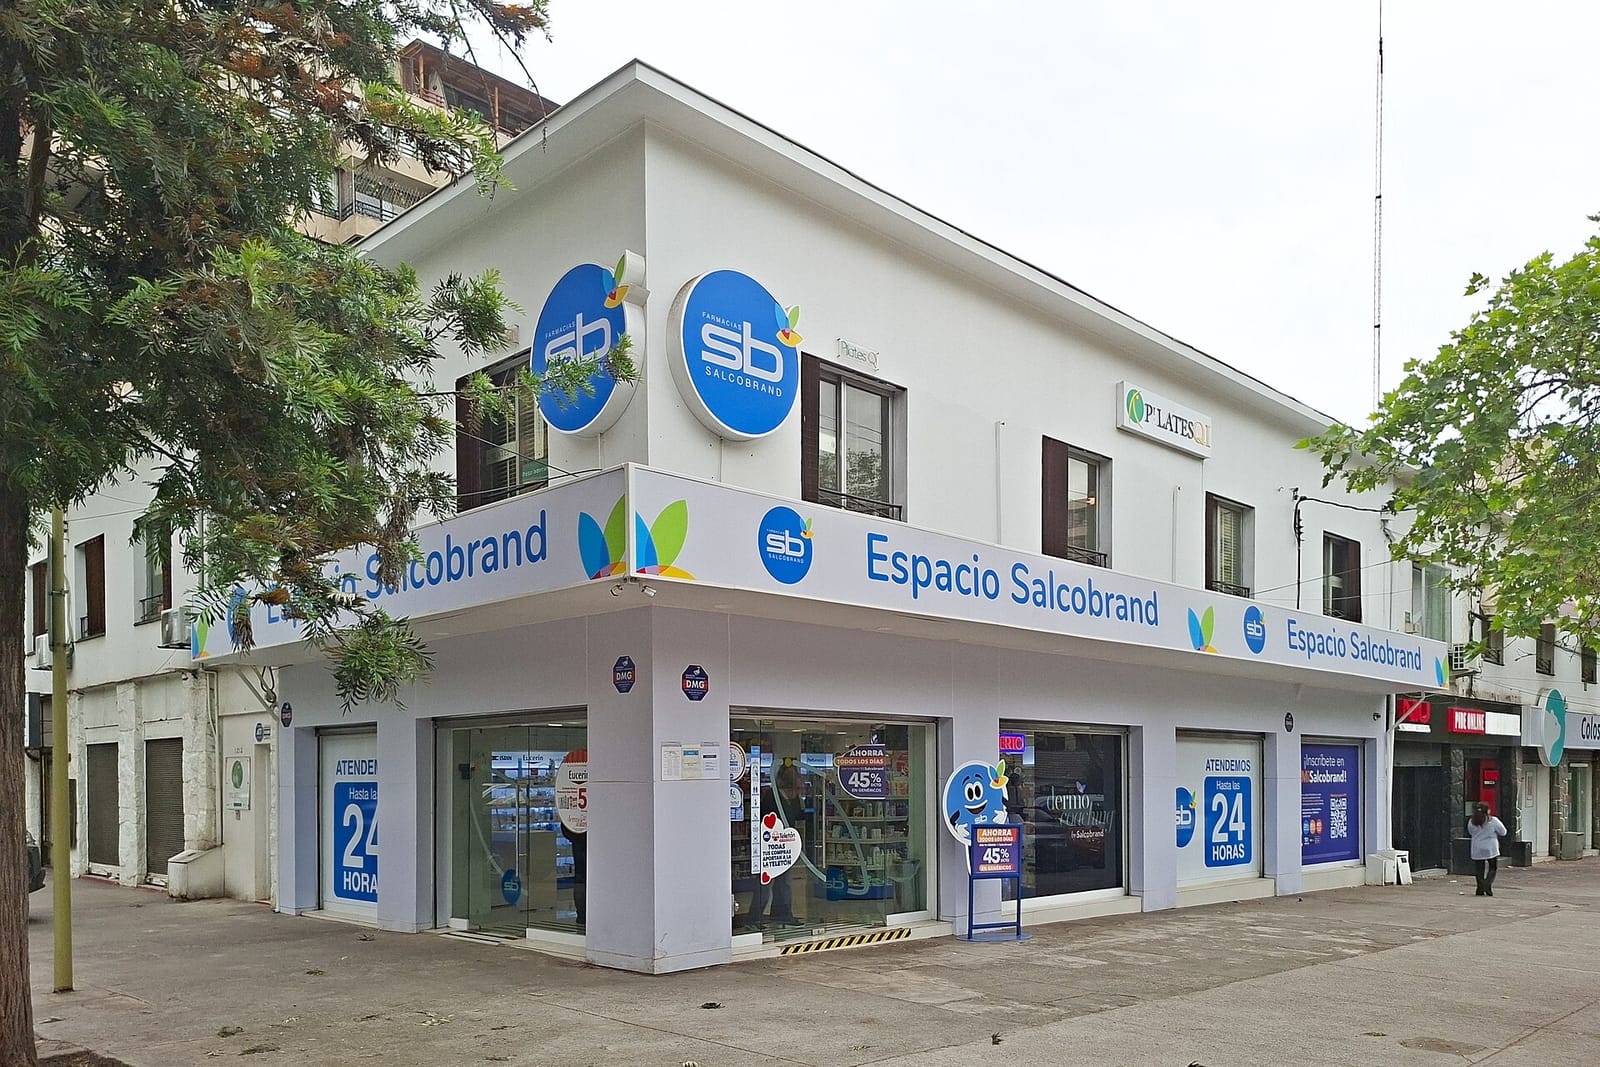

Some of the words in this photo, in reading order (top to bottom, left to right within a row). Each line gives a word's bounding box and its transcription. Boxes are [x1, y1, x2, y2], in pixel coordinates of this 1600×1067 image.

[702, 311, 742, 331] FARMACIAS
[701, 321, 784, 383] sb
[705, 365, 783, 397] SALCOBRAND
[766, 529, 805, 558] sb
[867, 532, 1000, 599] Espacio
[1010, 562, 1159, 626] Salcobrand
[1246, 619, 1263, 637] sb
[1287, 619, 1346, 660] Espacio
[1350, 631, 1422, 671] Salcobrand
[616, 671, 633, 681] DMG
[686, 679, 705, 689] DMG
[869, 757, 884, 765] DÍAS
[1205, 759, 1251, 772] ATENDEMOS
[1336, 758, 1344, 766] en
[348, 787, 369, 800] Hasta
[1216, 780, 1231, 790] Hasta
[1232, 781, 1240, 790] las
[1046, 785, 1090, 811] dermo
[1212, 792, 1246, 843] 24
[982, 828, 1012, 837] AHORRA
[1076, 829, 1105, 839] Salcobrand
[1212, 843, 1245, 861] HORAS
